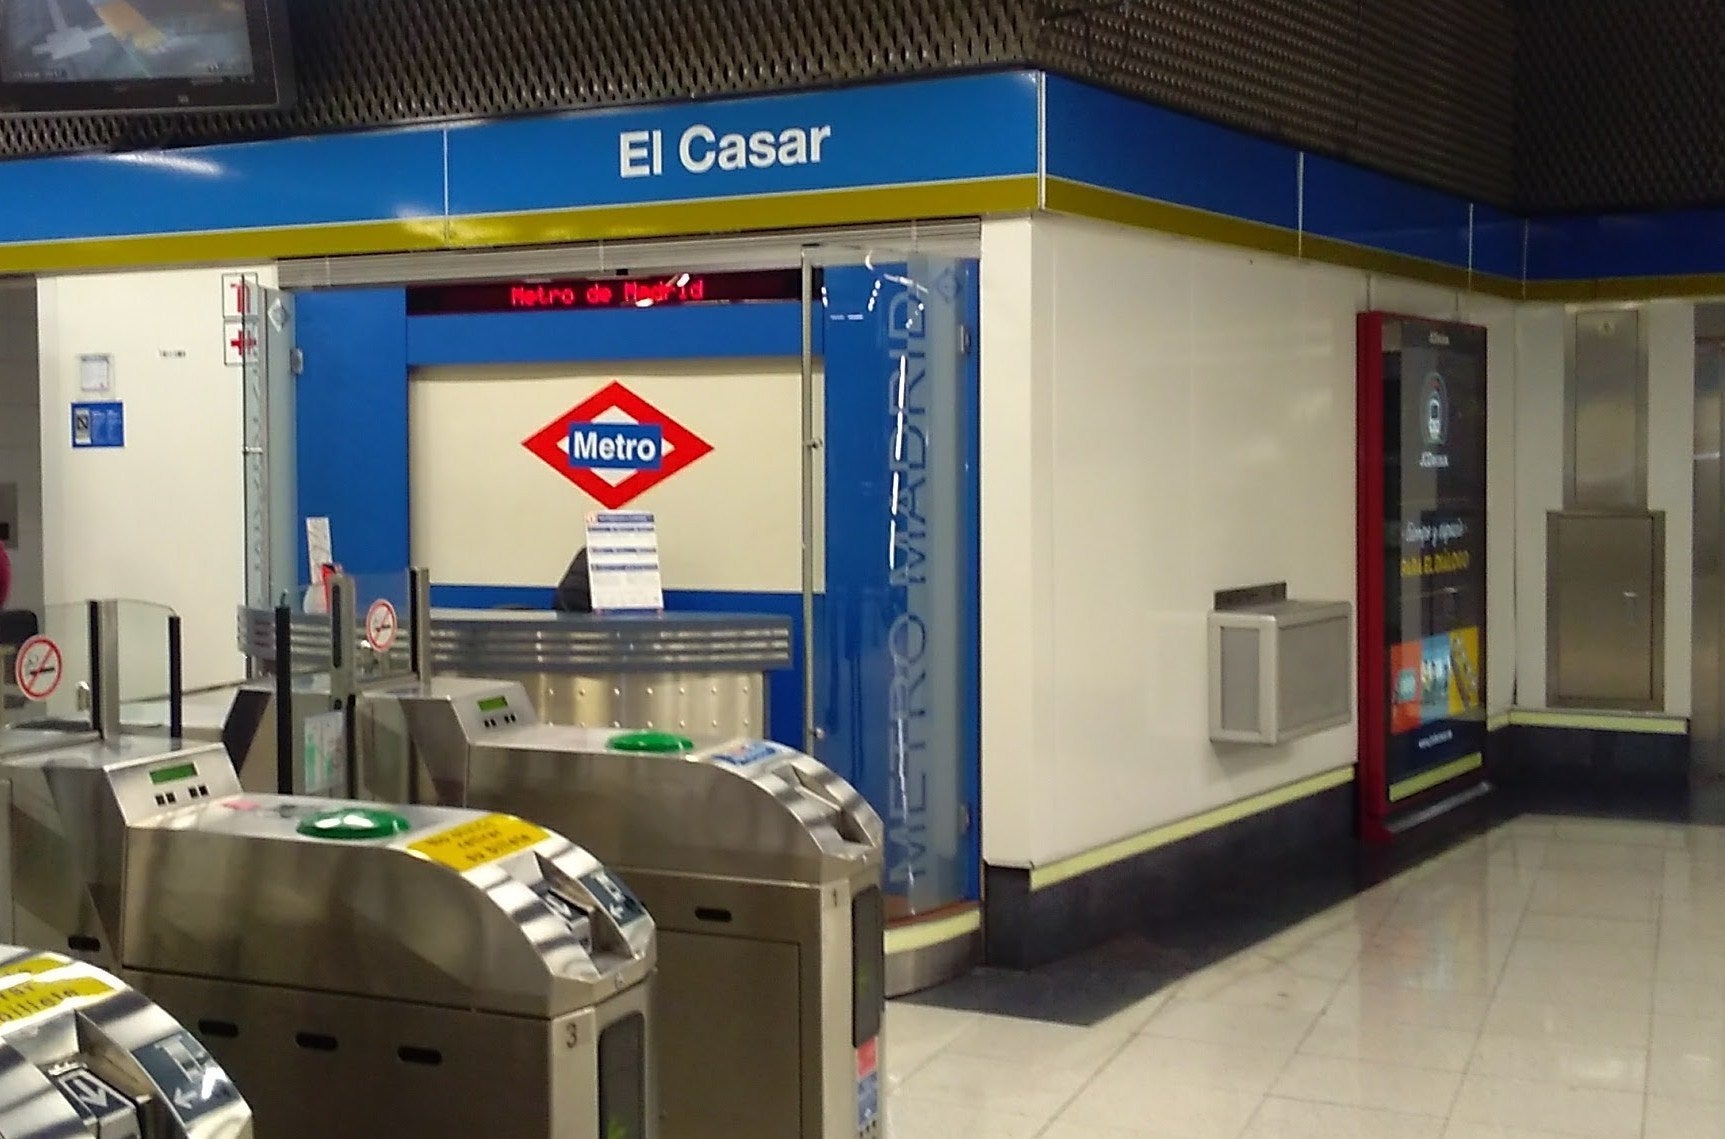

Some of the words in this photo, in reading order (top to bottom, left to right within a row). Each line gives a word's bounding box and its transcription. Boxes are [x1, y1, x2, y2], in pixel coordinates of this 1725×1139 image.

[620, 129, 662, 178] El
[679, 123, 832, 174] Casar
[511, 285, 575, 306] Metro
[586, 280, 613, 303] de
[624, 279, 704, 302] Madrid
[573, 430, 656, 462] Metro
[889, 292, 926, 586] MADRID
[889, 612, 926, 881] METRO
[565, 1022, 578, 1049] 3
